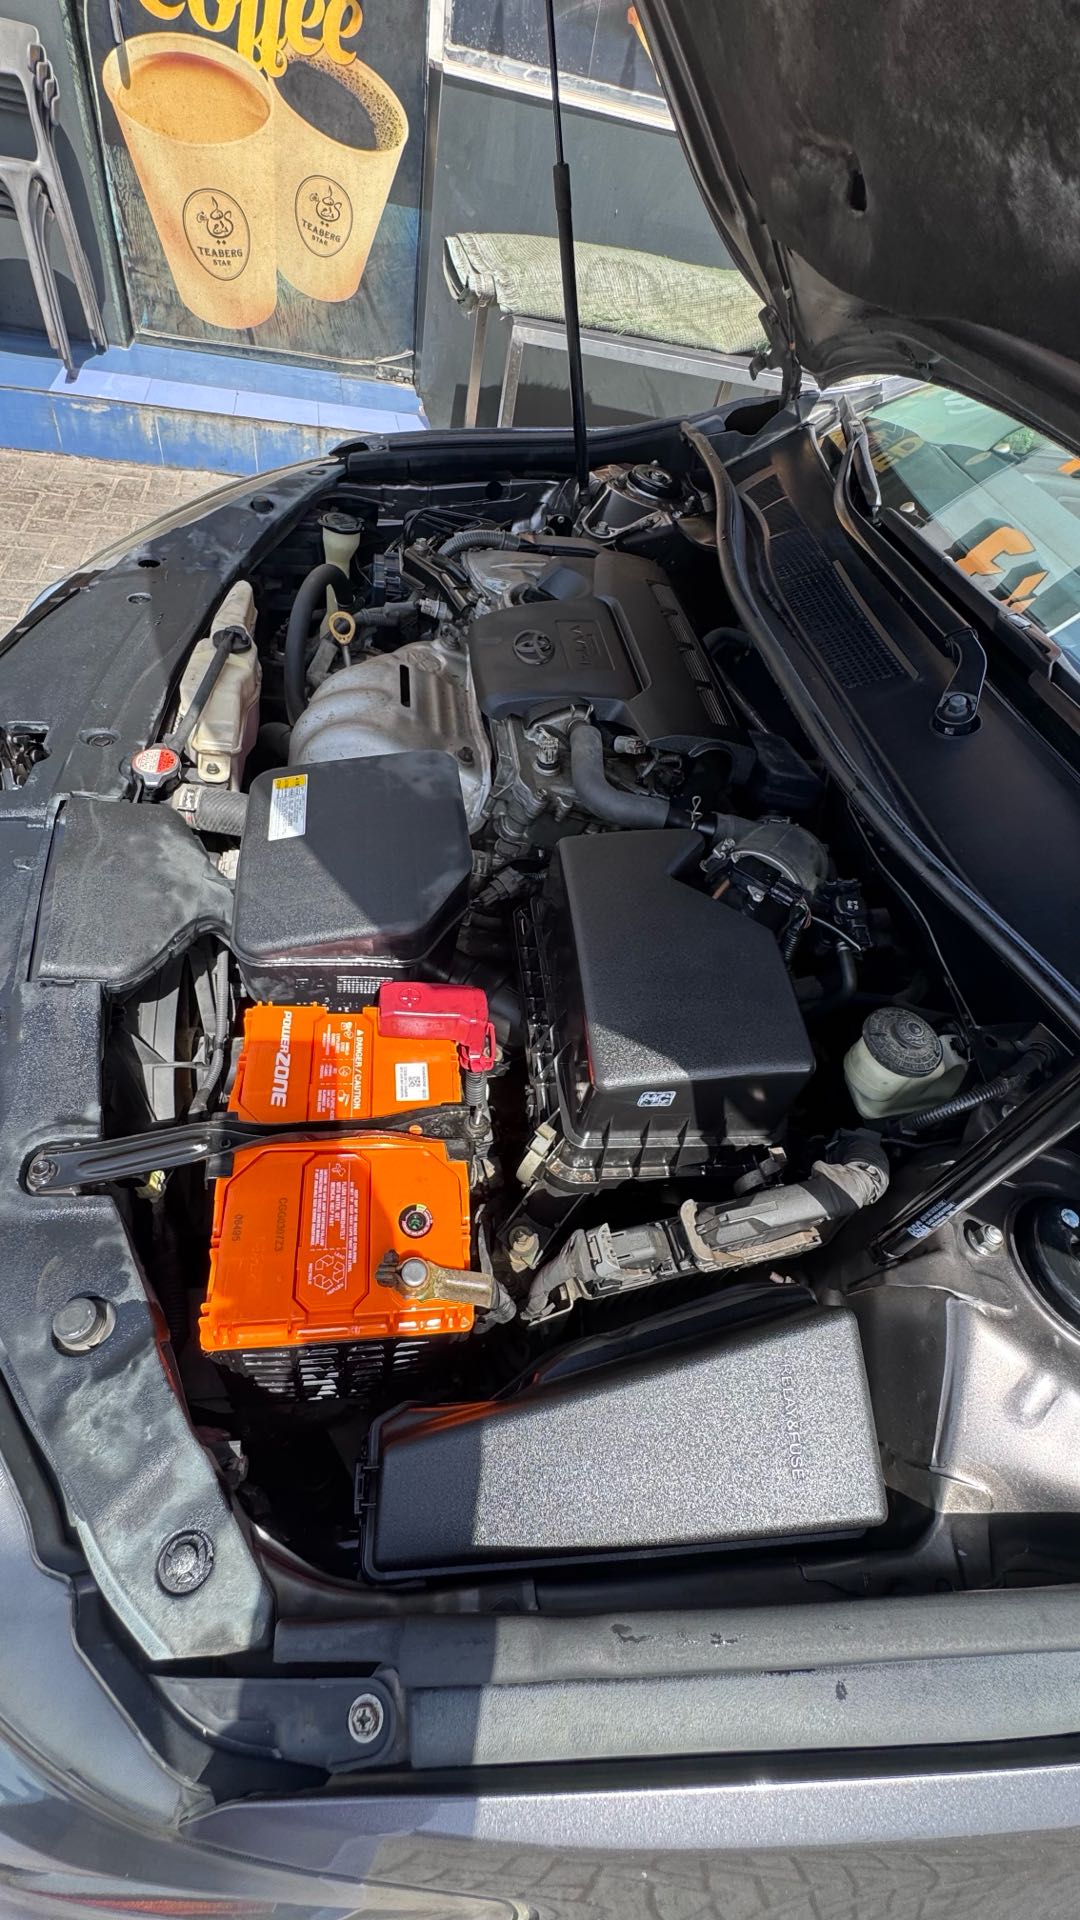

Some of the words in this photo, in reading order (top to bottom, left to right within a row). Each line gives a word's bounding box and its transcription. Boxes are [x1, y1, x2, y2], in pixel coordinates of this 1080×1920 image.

[139, 0, 363, 78] offee
[301, 218, 341, 243] TEABERG
[311, 234, 328, 247] STAR
[196, 246, 243, 258] TEABERG
[213, 259, 232, 267] STAR
[353, 1074, 362, 1109] CAUTION
